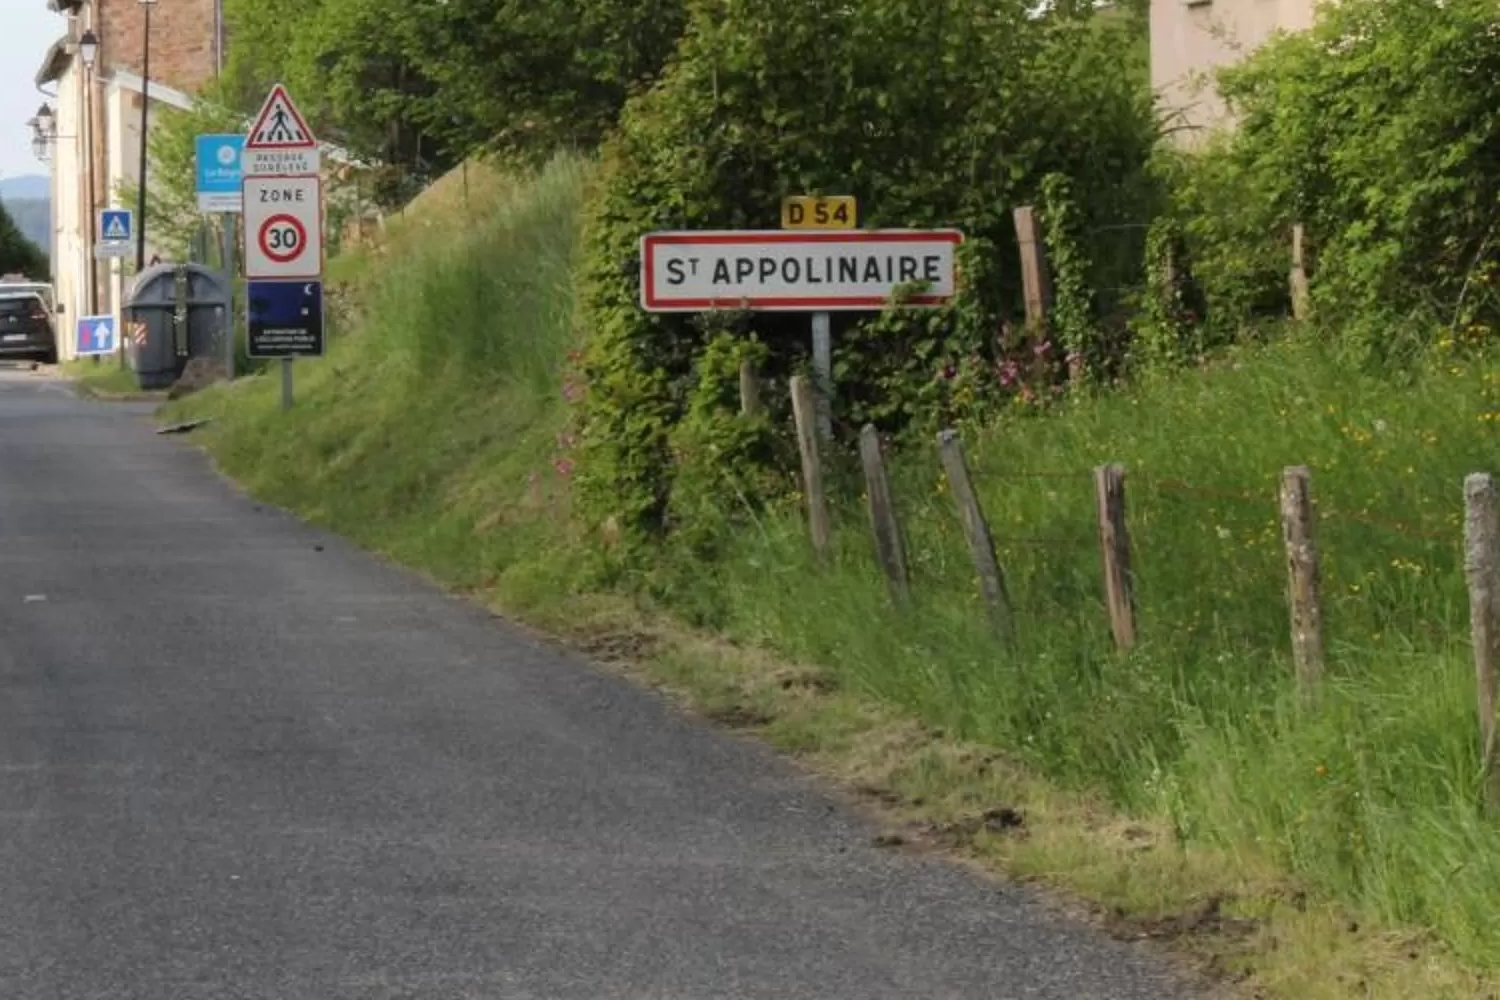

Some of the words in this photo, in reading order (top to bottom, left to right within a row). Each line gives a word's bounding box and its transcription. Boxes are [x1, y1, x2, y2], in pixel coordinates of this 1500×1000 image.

[260, 189, 304, 203] ZONE
[789, 204, 804, 225] D
[814, 203, 849, 224] 54
[269, 228, 297, 249] 30
[712, 255, 941, 285] APPOLINAIRE
